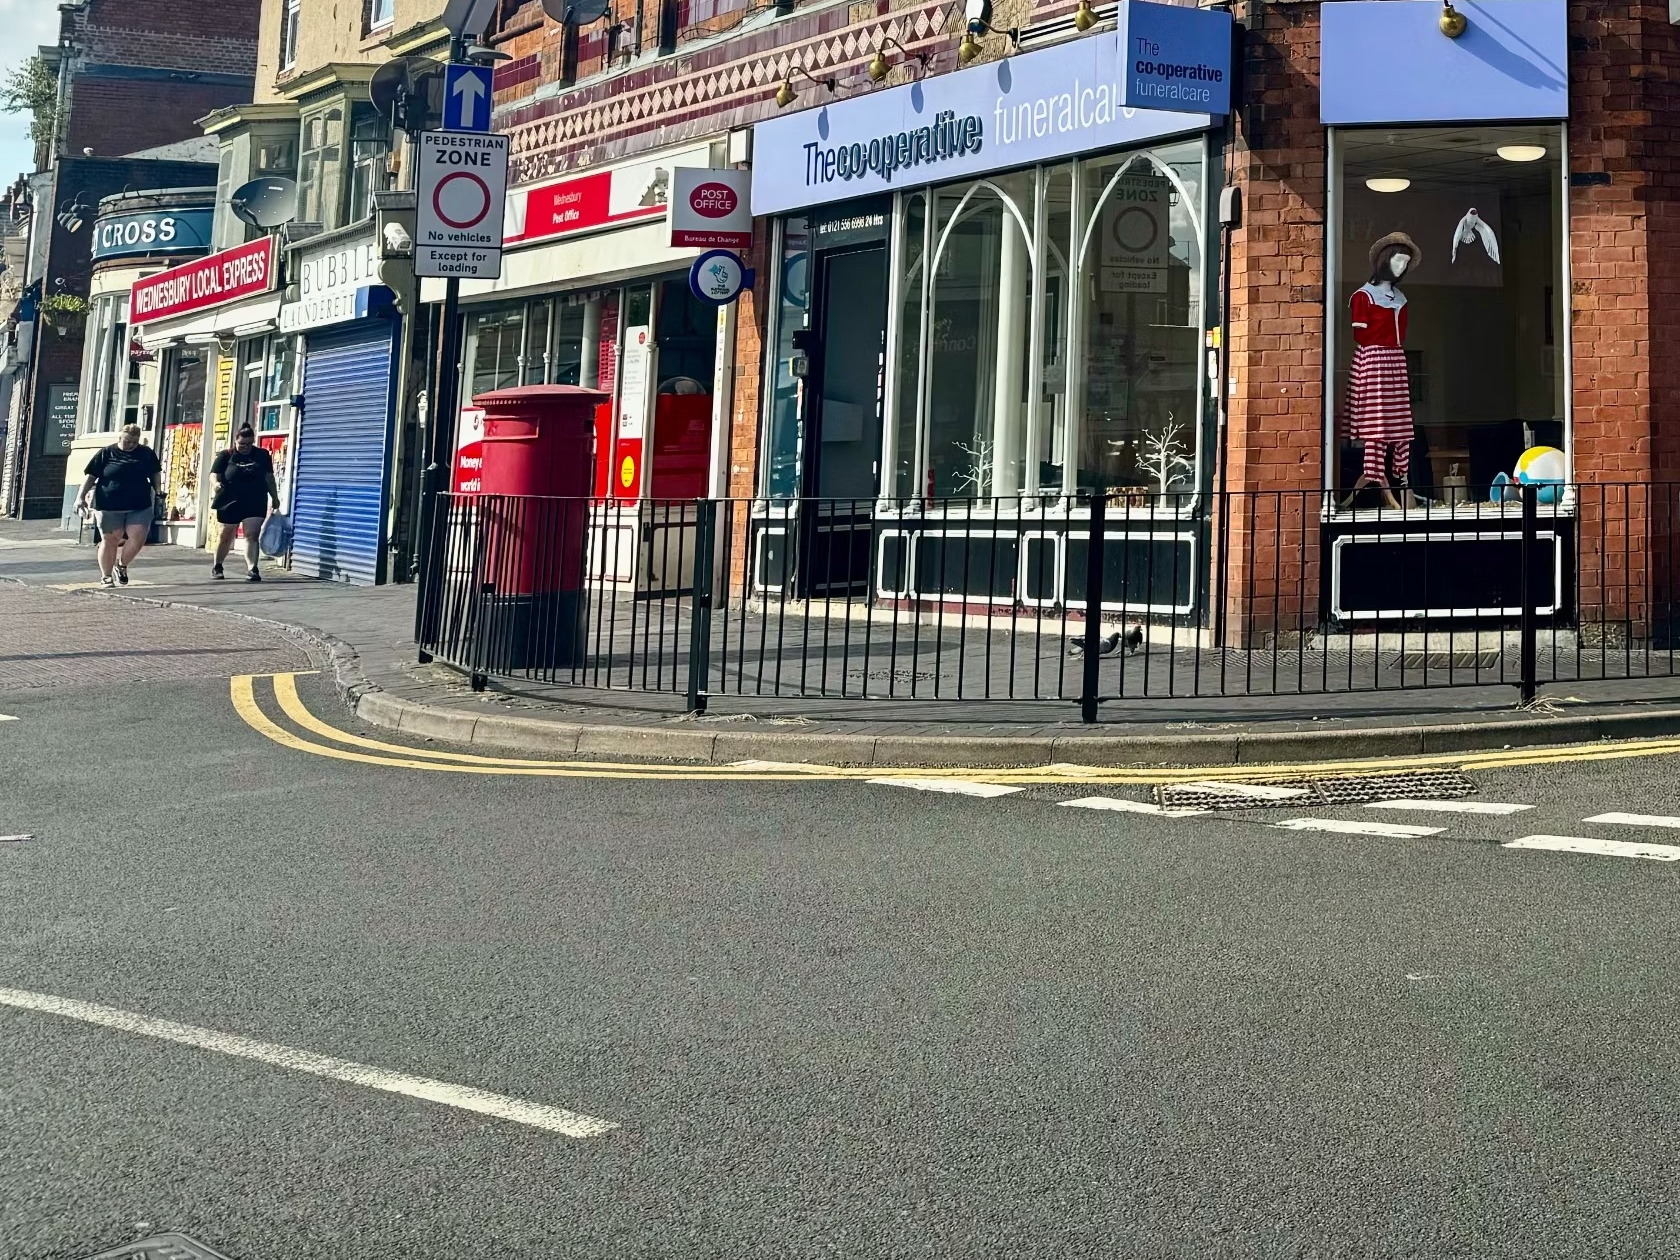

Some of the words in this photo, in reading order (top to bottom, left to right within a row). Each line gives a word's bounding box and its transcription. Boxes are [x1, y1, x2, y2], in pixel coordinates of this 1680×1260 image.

[1136, 36, 1160, 57] The
[1135, 78, 1210, 102] funeralcare
[425, 135, 504, 150] PEDESTRIAN
[435, 149, 492, 167] ZONE
[802, 140, 837, 186] The
[701, 189, 729, 200] POST
[693, 199, 732, 210] OFFICE
[552, 212, 564, 225] Post
[564, 208, 580, 222] Office
[102, 217, 176, 248] CROSS
[428, 230, 444, 241] No
[447, 232, 492, 243] vehicles
[717, 236, 740, 244] Change
[430, 250, 469, 265] Except
[471, 251, 487, 262] for
[438, 262, 478, 275] loading
[136, 273, 191, 315] WEDNESBURY
[192, 265, 223, 300] LOCAL
[222, 250, 266, 292] EXPRESS
[460, 455, 479, 472] Money
